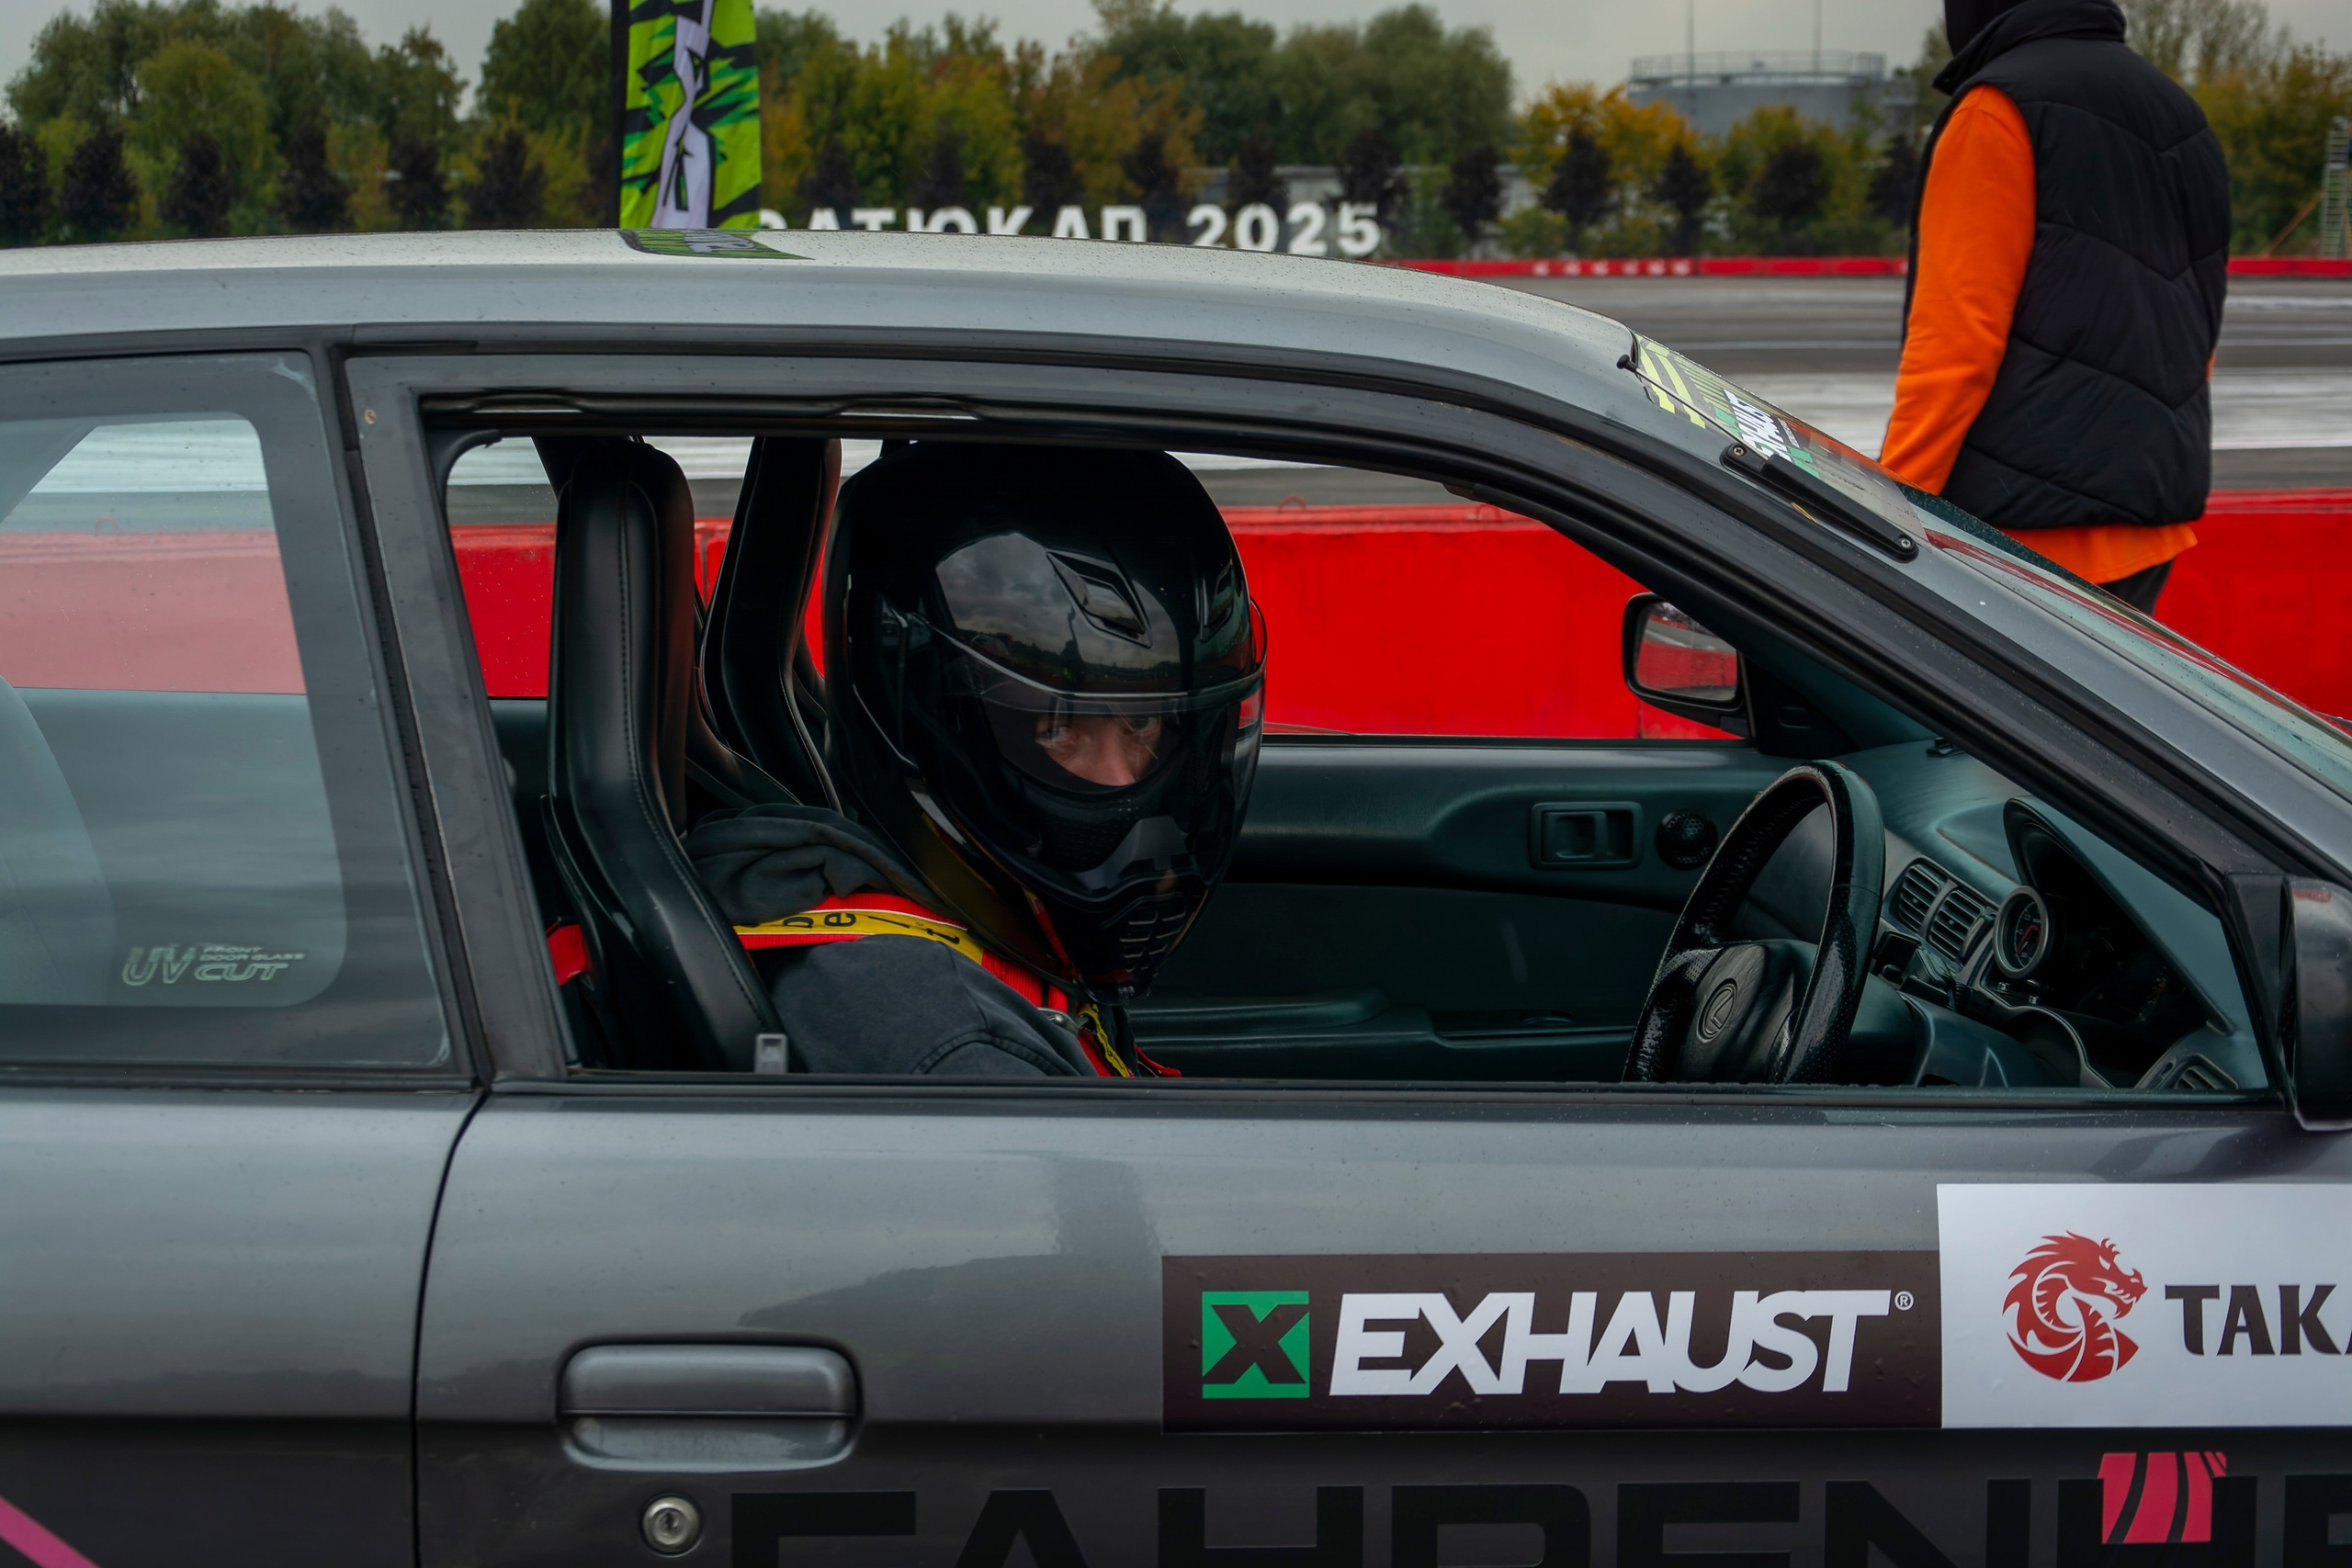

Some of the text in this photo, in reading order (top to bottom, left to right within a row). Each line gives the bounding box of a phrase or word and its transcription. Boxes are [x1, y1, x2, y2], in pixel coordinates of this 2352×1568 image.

[1186, 202, 1381, 257] 2025
[122, 946, 196, 986] UV
[195, 963, 289, 981] CUT
[2165, 1284, 2352, 1356] TAK
